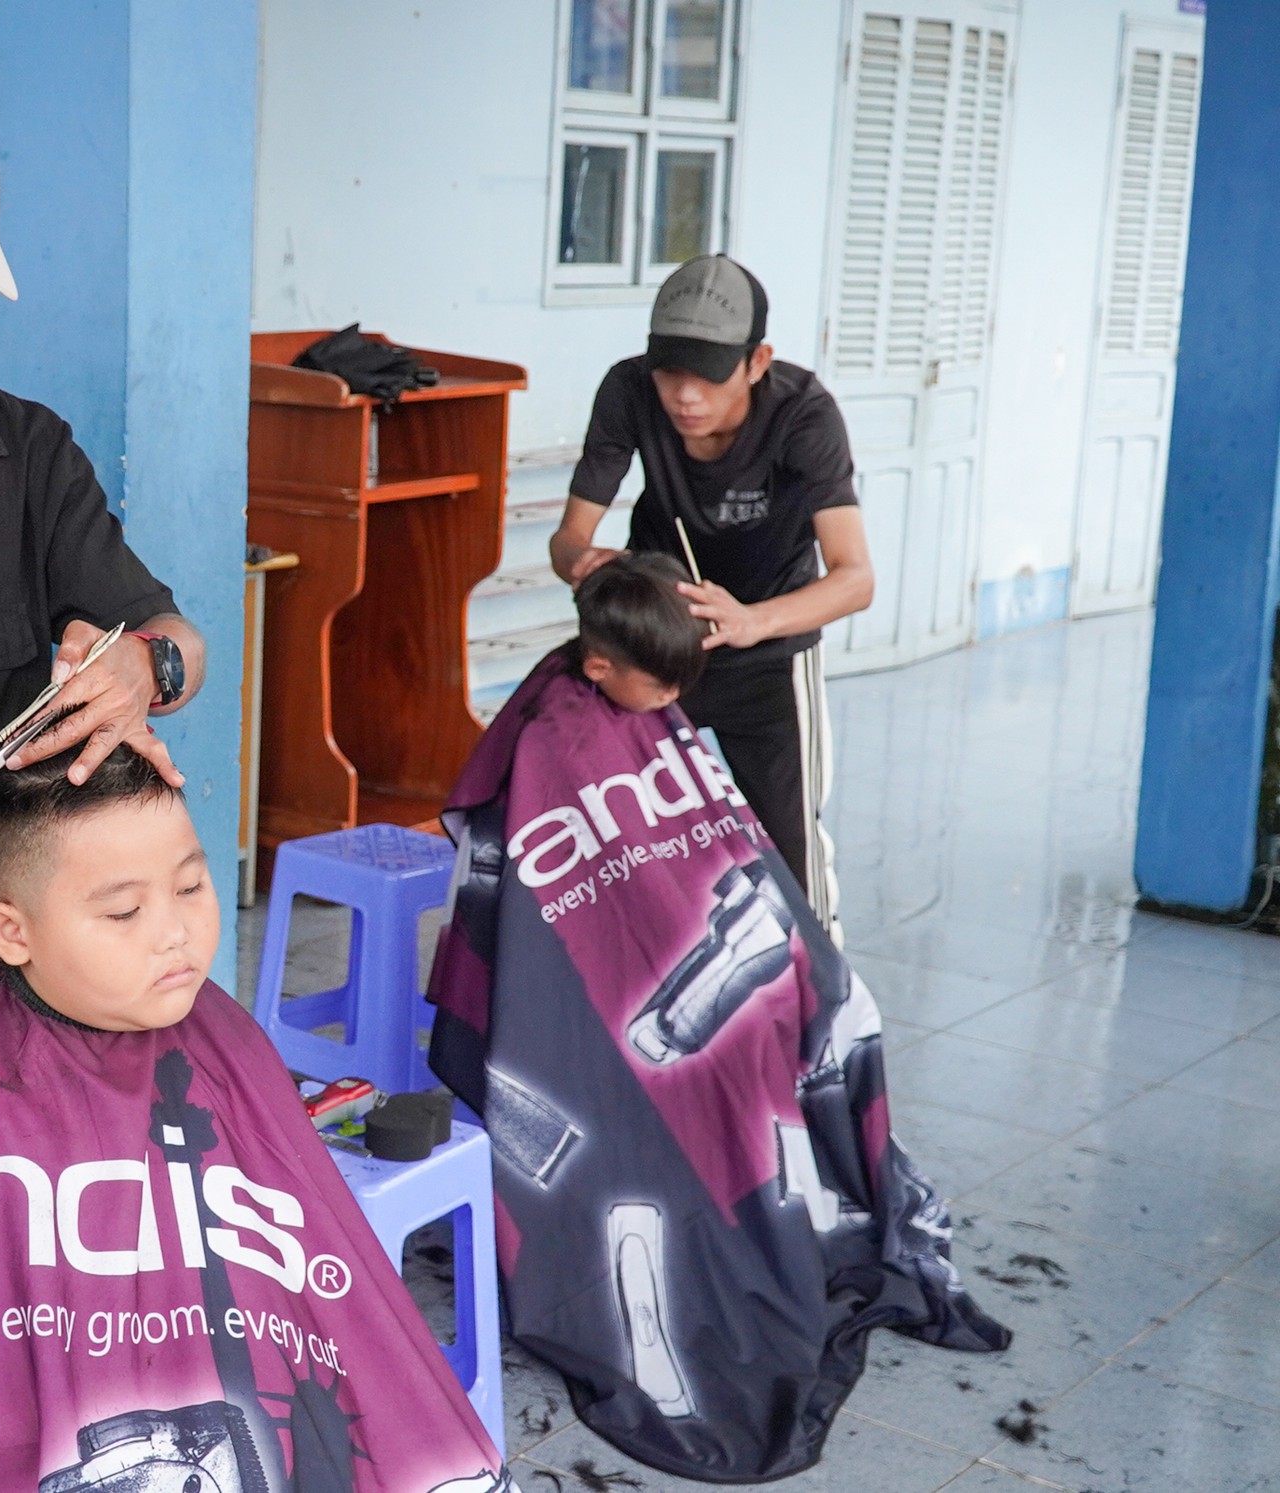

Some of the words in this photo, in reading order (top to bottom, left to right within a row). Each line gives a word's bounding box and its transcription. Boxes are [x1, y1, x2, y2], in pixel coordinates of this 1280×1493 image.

[540, 876, 597, 924] every
[598, 845, 654, 887] style.
[2, 1303, 76, 1353] every
[87, 1304, 216, 1357] groom.
[224, 1307, 304, 1364] every
[308, 1333, 348, 1376] cut.
